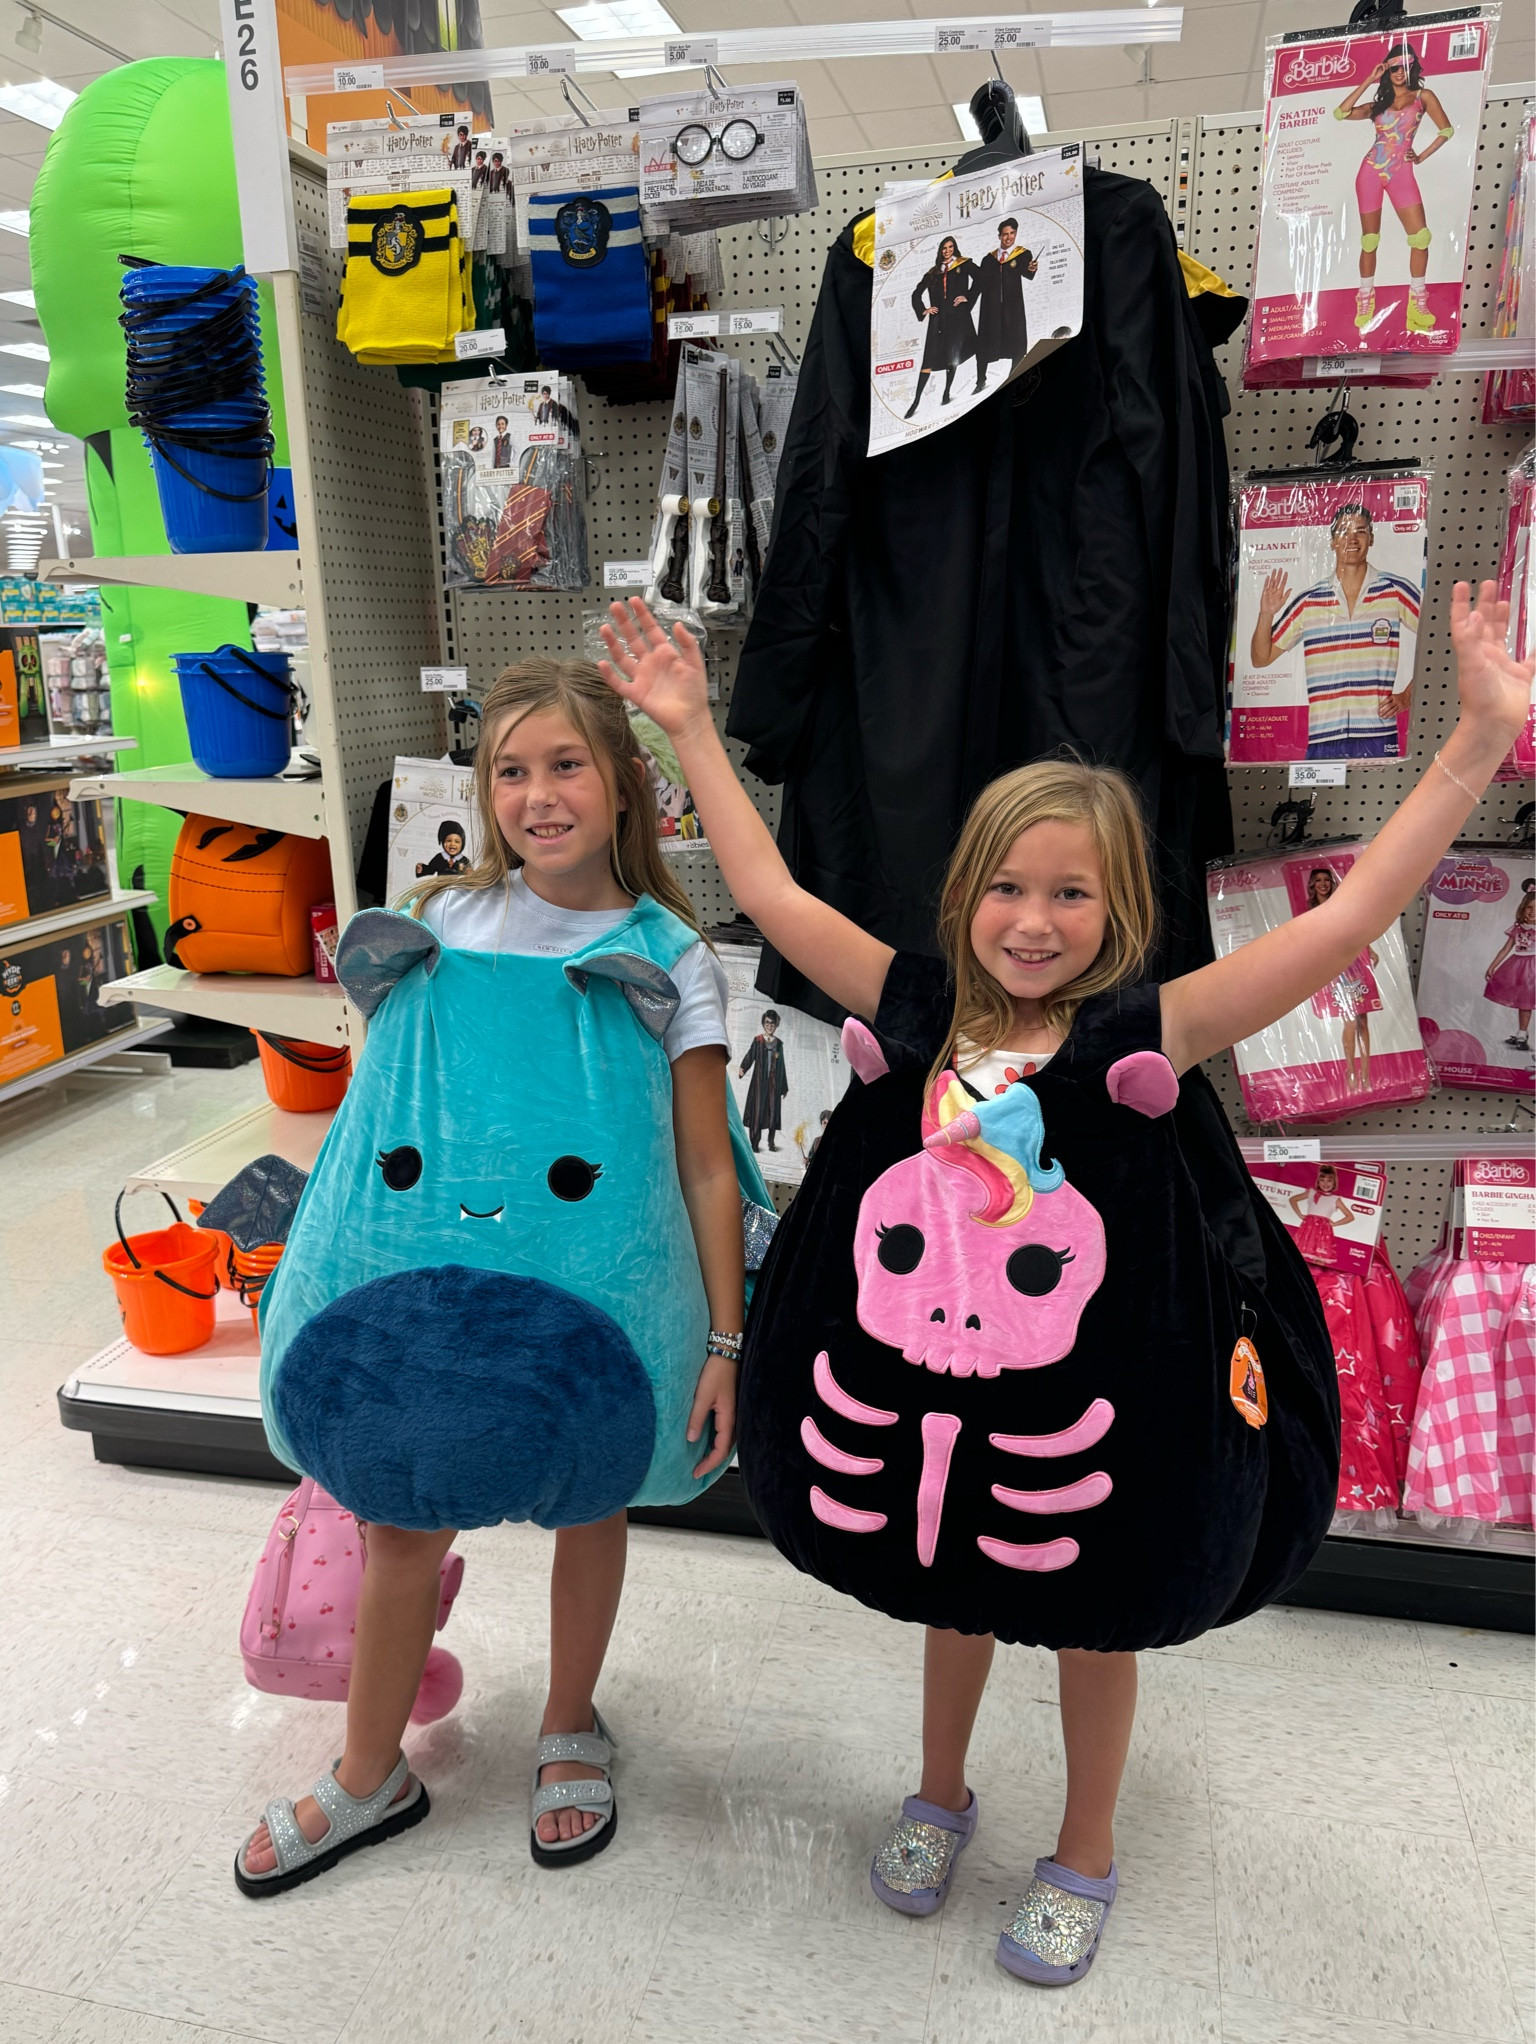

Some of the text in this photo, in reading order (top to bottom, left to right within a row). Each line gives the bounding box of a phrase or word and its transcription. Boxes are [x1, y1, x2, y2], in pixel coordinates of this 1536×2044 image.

[939, 36, 961, 46] 25.00
[994, 33, 1017, 43] 25.00
[669, 51, 686, 61] 5.00
[529, 61, 549, 70] 10.00
[1285, 56, 1350, 84] Barbie
[338, 76, 357, 86] 10.00
[1280, 106, 1326, 121] SKATING
[1279, 116, 1319, 130] BARBIE
[387, 136, 411, 154] Harry
[410, 132, 434, 153] Potter
[573, 137, 598, 154] Harry
[597, 132, 623, 153] Potter
[1278, 138, 1321, 149] ADULT COSTUME
[1273, 181, 1300, 190] COSTUME
[957, 171, 1045, 219] Harry Potter
[909, 211, 944, 232] WIZARDING WORLD
[675, 325, 694, 333] 15.00
[734, 321, 753, 330] 15.00
[459, 342, 478, 353] 20.00
[877, 364, 895, 373] ONLY
[1322, 360, 1345, 370] 25.00
[480, 391, 527, 411] Harry Potter
[904, 421, 940, 438] HOGWARTS
[480, 470, 495, 478] HARRY
[1280, 542, 1297, 550] KIT
[609, 573, 628, 581] 25.00
[425, 678, 443, 686] 25.00
[1294, 772, 1317, 780] 35.00
[1437, 873, 1503, 893] MINNIE
[1444, 1066, 1473, 1074] MOUSE
[1267, 1148, 1289, 1156] 25.00
[1474, 1161, 1525, 1179] Barbie
[1277, 1188, 1293, 1197] KIT
[1472, 1190, 1504, 1199] BARBIE
[1479, 1232, 1516, 1240] CHILD/ENFANT
